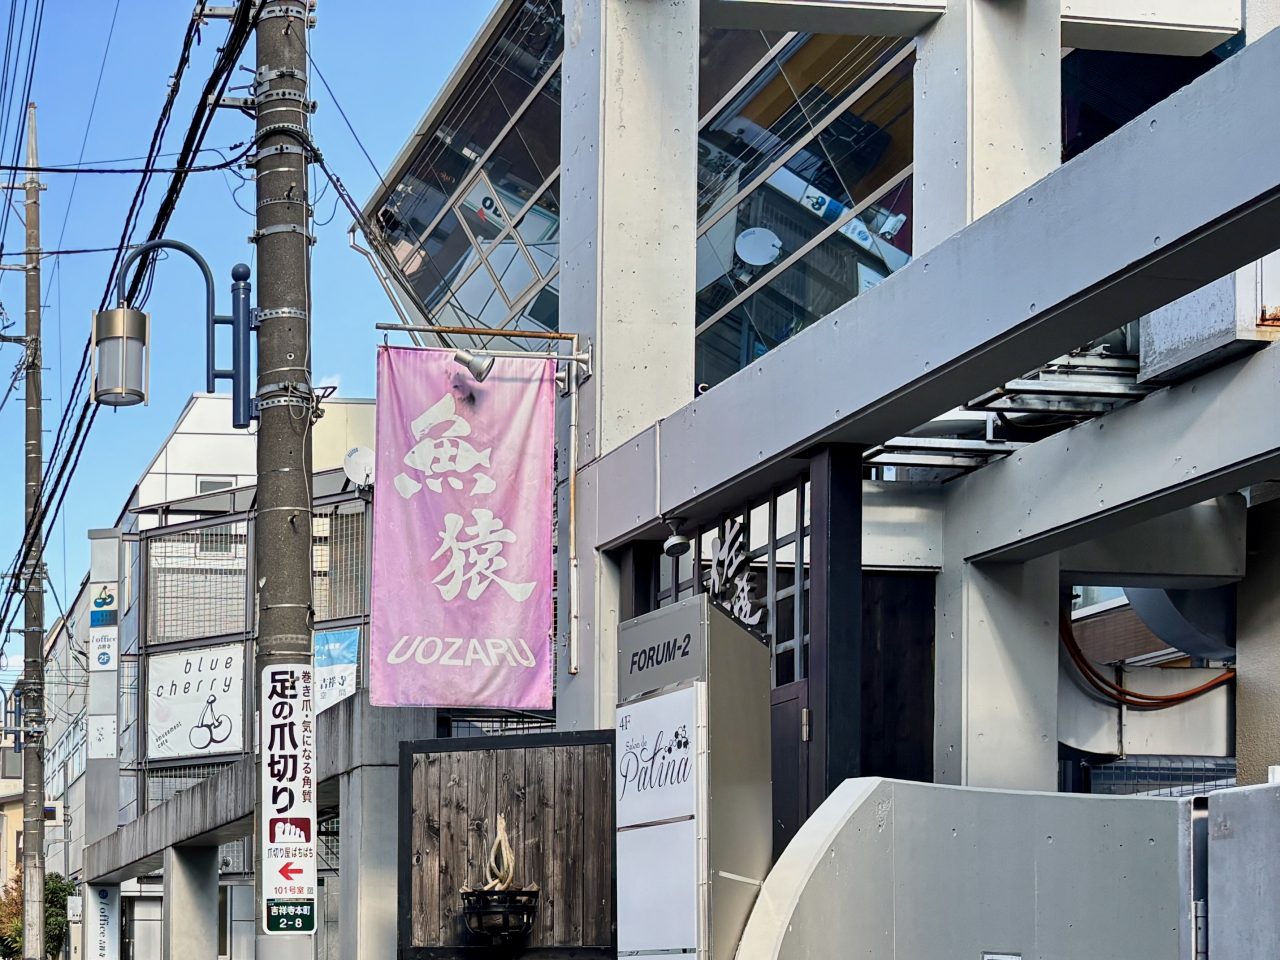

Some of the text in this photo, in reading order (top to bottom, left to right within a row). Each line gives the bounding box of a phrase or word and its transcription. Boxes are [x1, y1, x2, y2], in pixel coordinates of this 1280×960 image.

[393, 393, 537, 602] 魚猿
[99, 655, 110, 663] 2F
[386, 635, 537, 668] UOZARU
[629, 633, 692, 675] FORUM-2
[184, 656, 233, 674] blue
[156, 676, 233, 698] cherry
[619, 715, 631, 731] 4F
[267, 670, 299, 815] 足の爪切り
[301, 670, 313, 803] 巻き爪・気になる角質
[270, 905, 311, 916] 吉祥寺本町
[279, 918, 303, 928] 2-8
